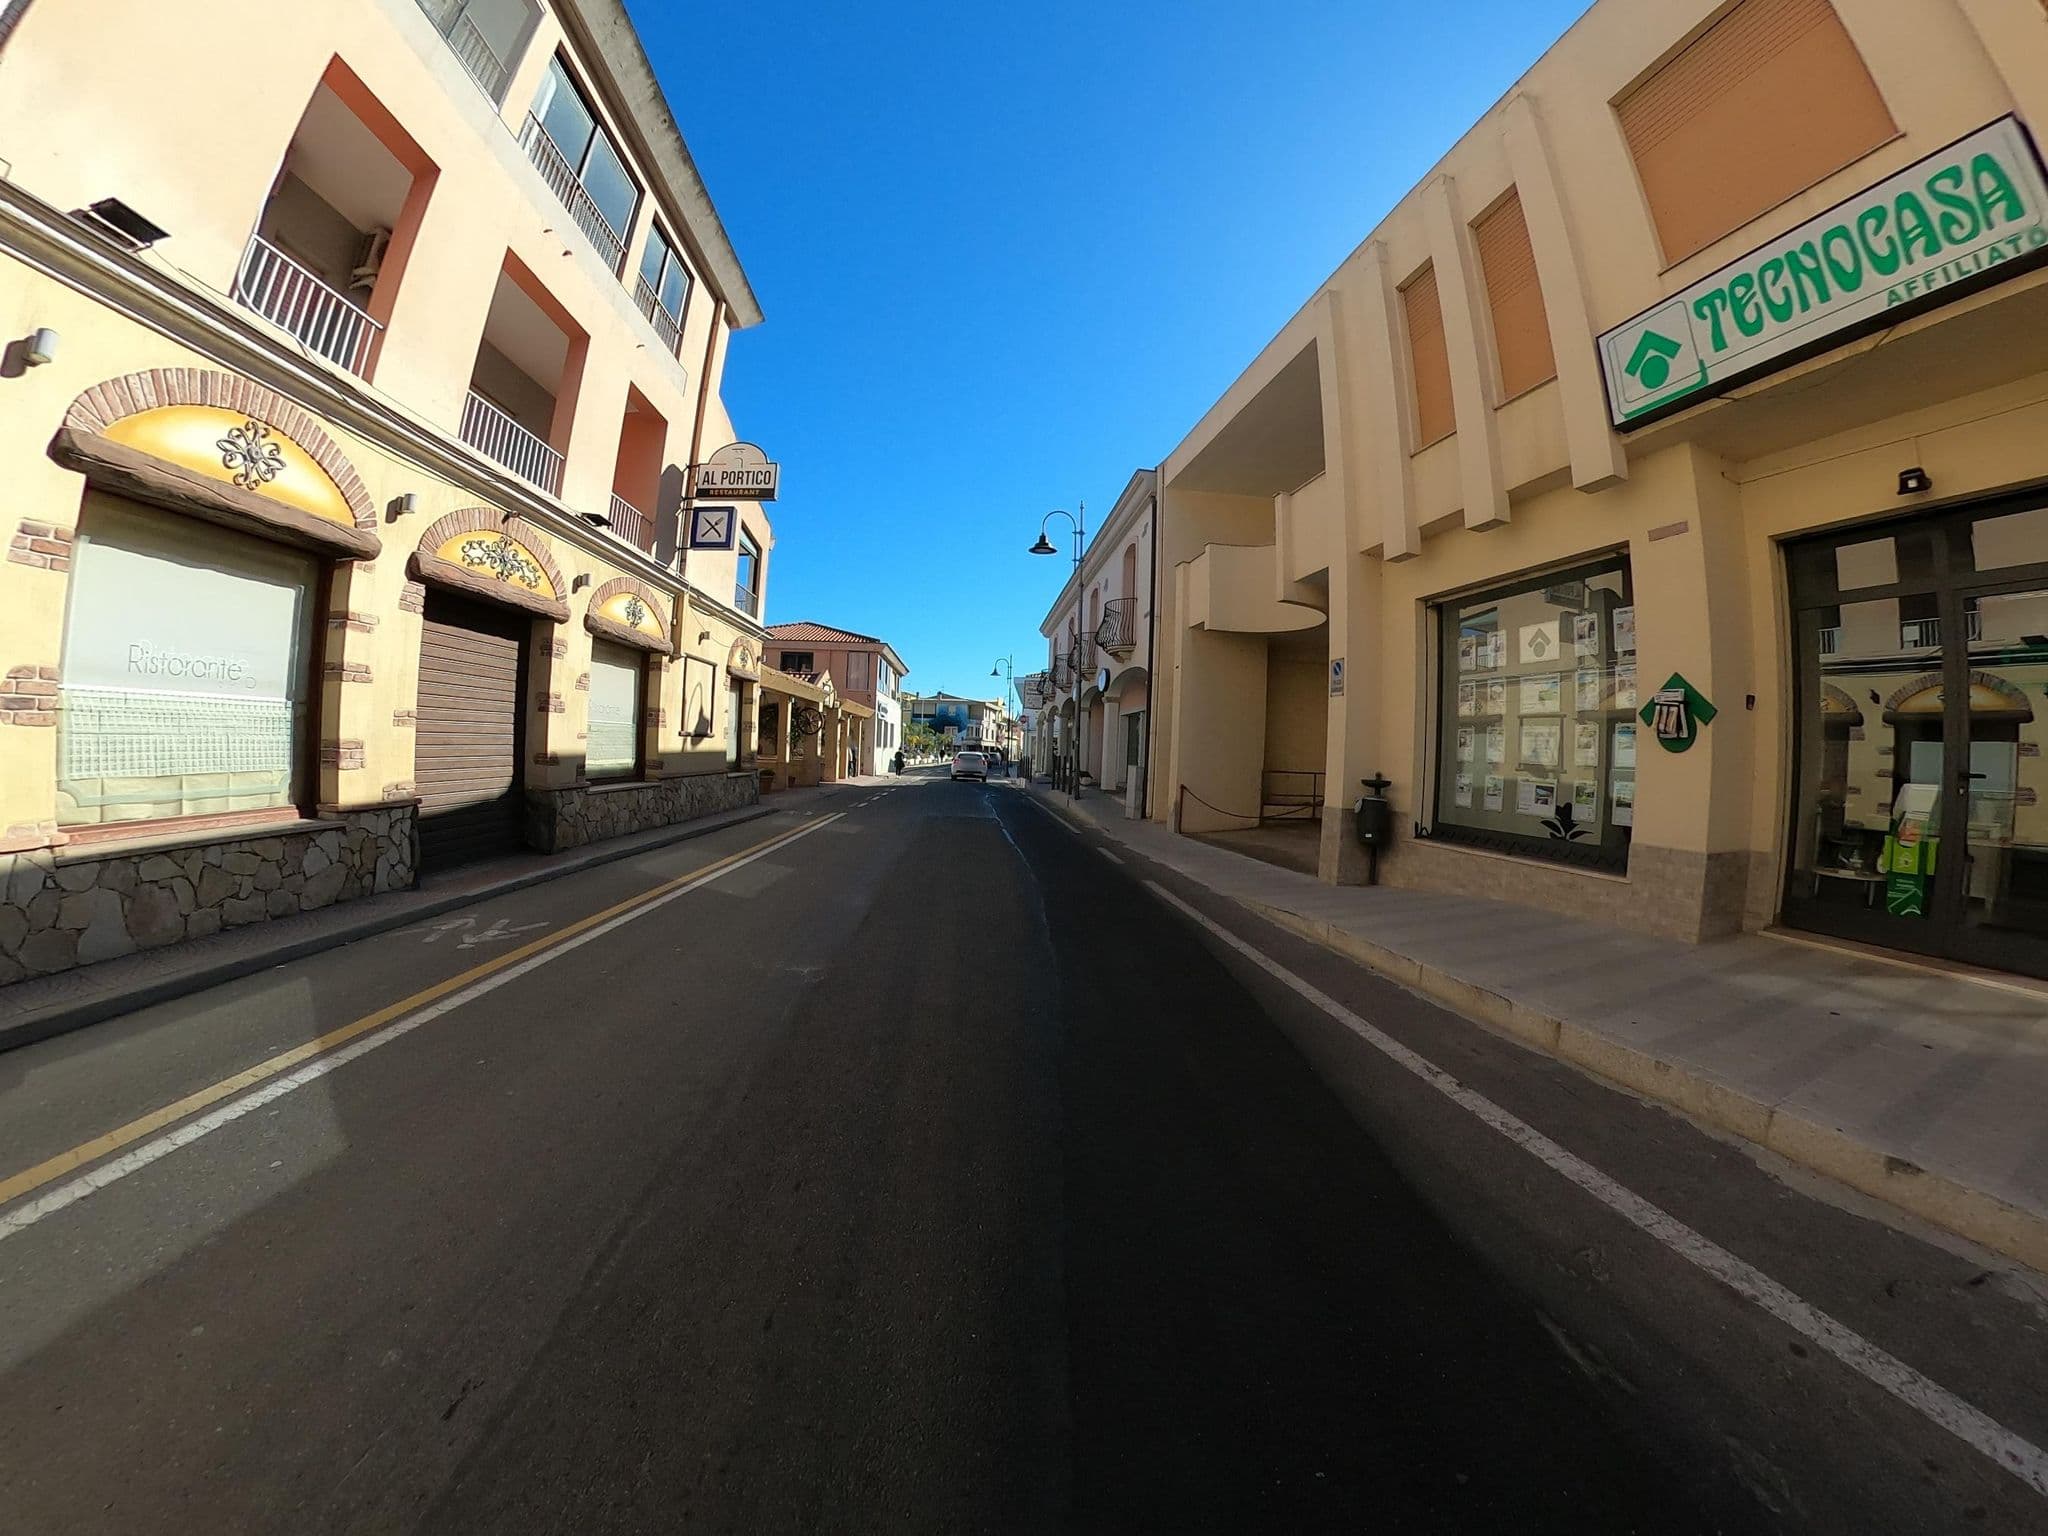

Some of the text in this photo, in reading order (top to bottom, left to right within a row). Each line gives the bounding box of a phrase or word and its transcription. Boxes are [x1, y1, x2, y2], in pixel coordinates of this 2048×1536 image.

[1693, 152, 2025, 353] TECNOCASA
[1887, 227, 2048, 307] AFFILIATO
[702, 470, 772, 486] AL PORTICO
[128, 643, 242, 681] Ristorante
